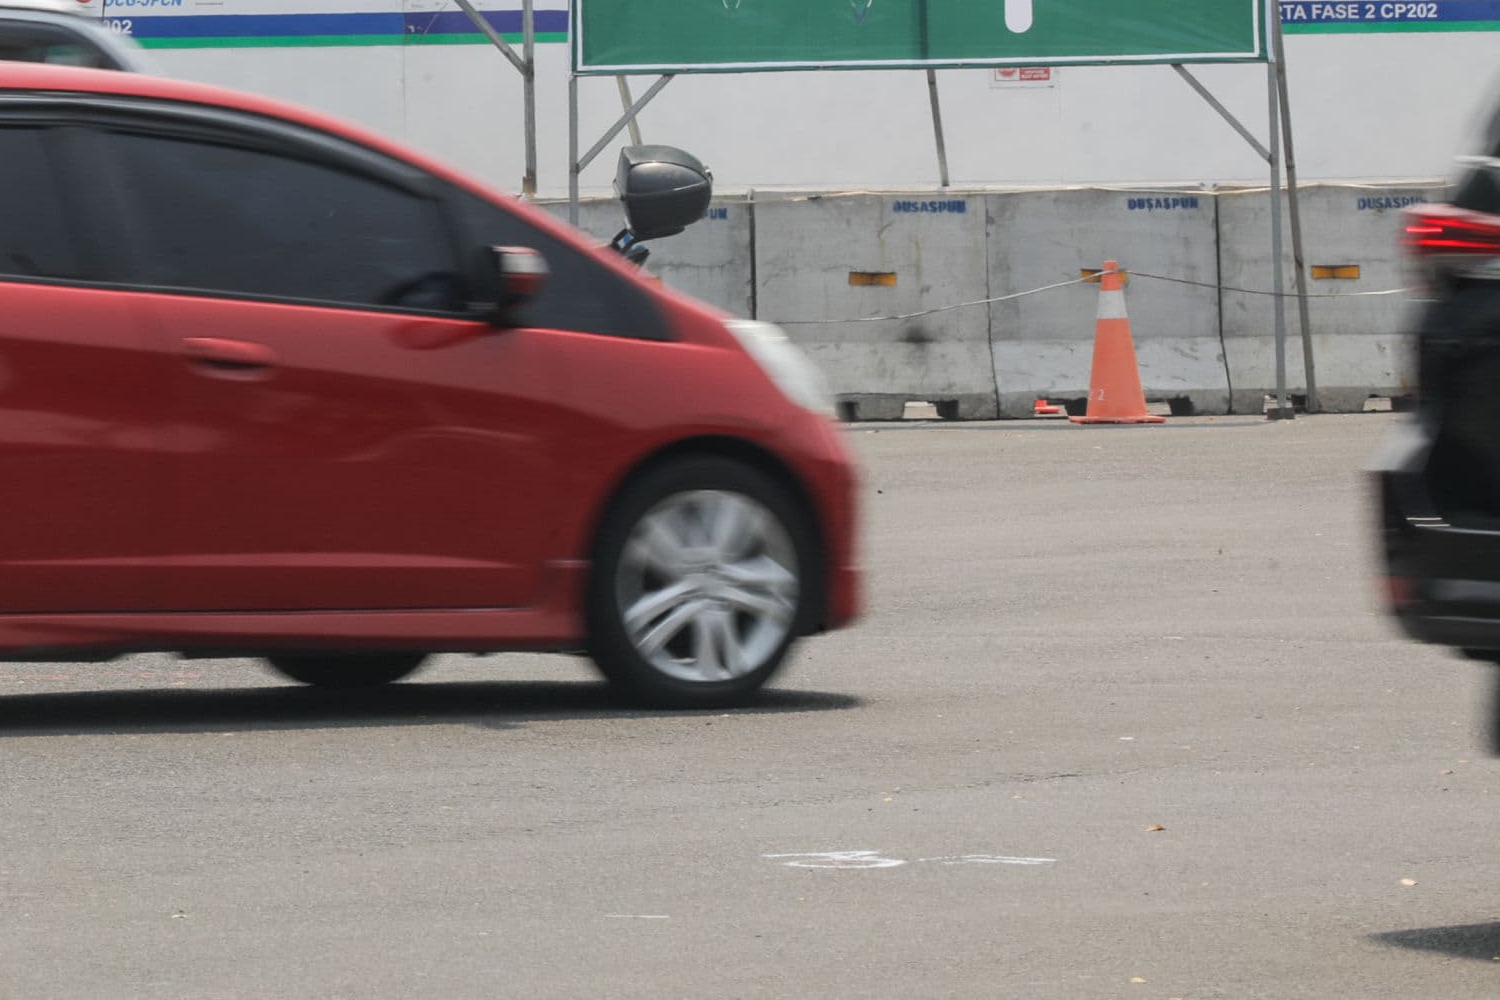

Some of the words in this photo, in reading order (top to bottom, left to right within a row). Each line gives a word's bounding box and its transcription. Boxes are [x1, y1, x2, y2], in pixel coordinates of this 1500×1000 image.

[1312, 4, 1359, 19] FASE
[1365, 4, 1376, 18] 2
[1380, 3, 1438, 18] CP202
